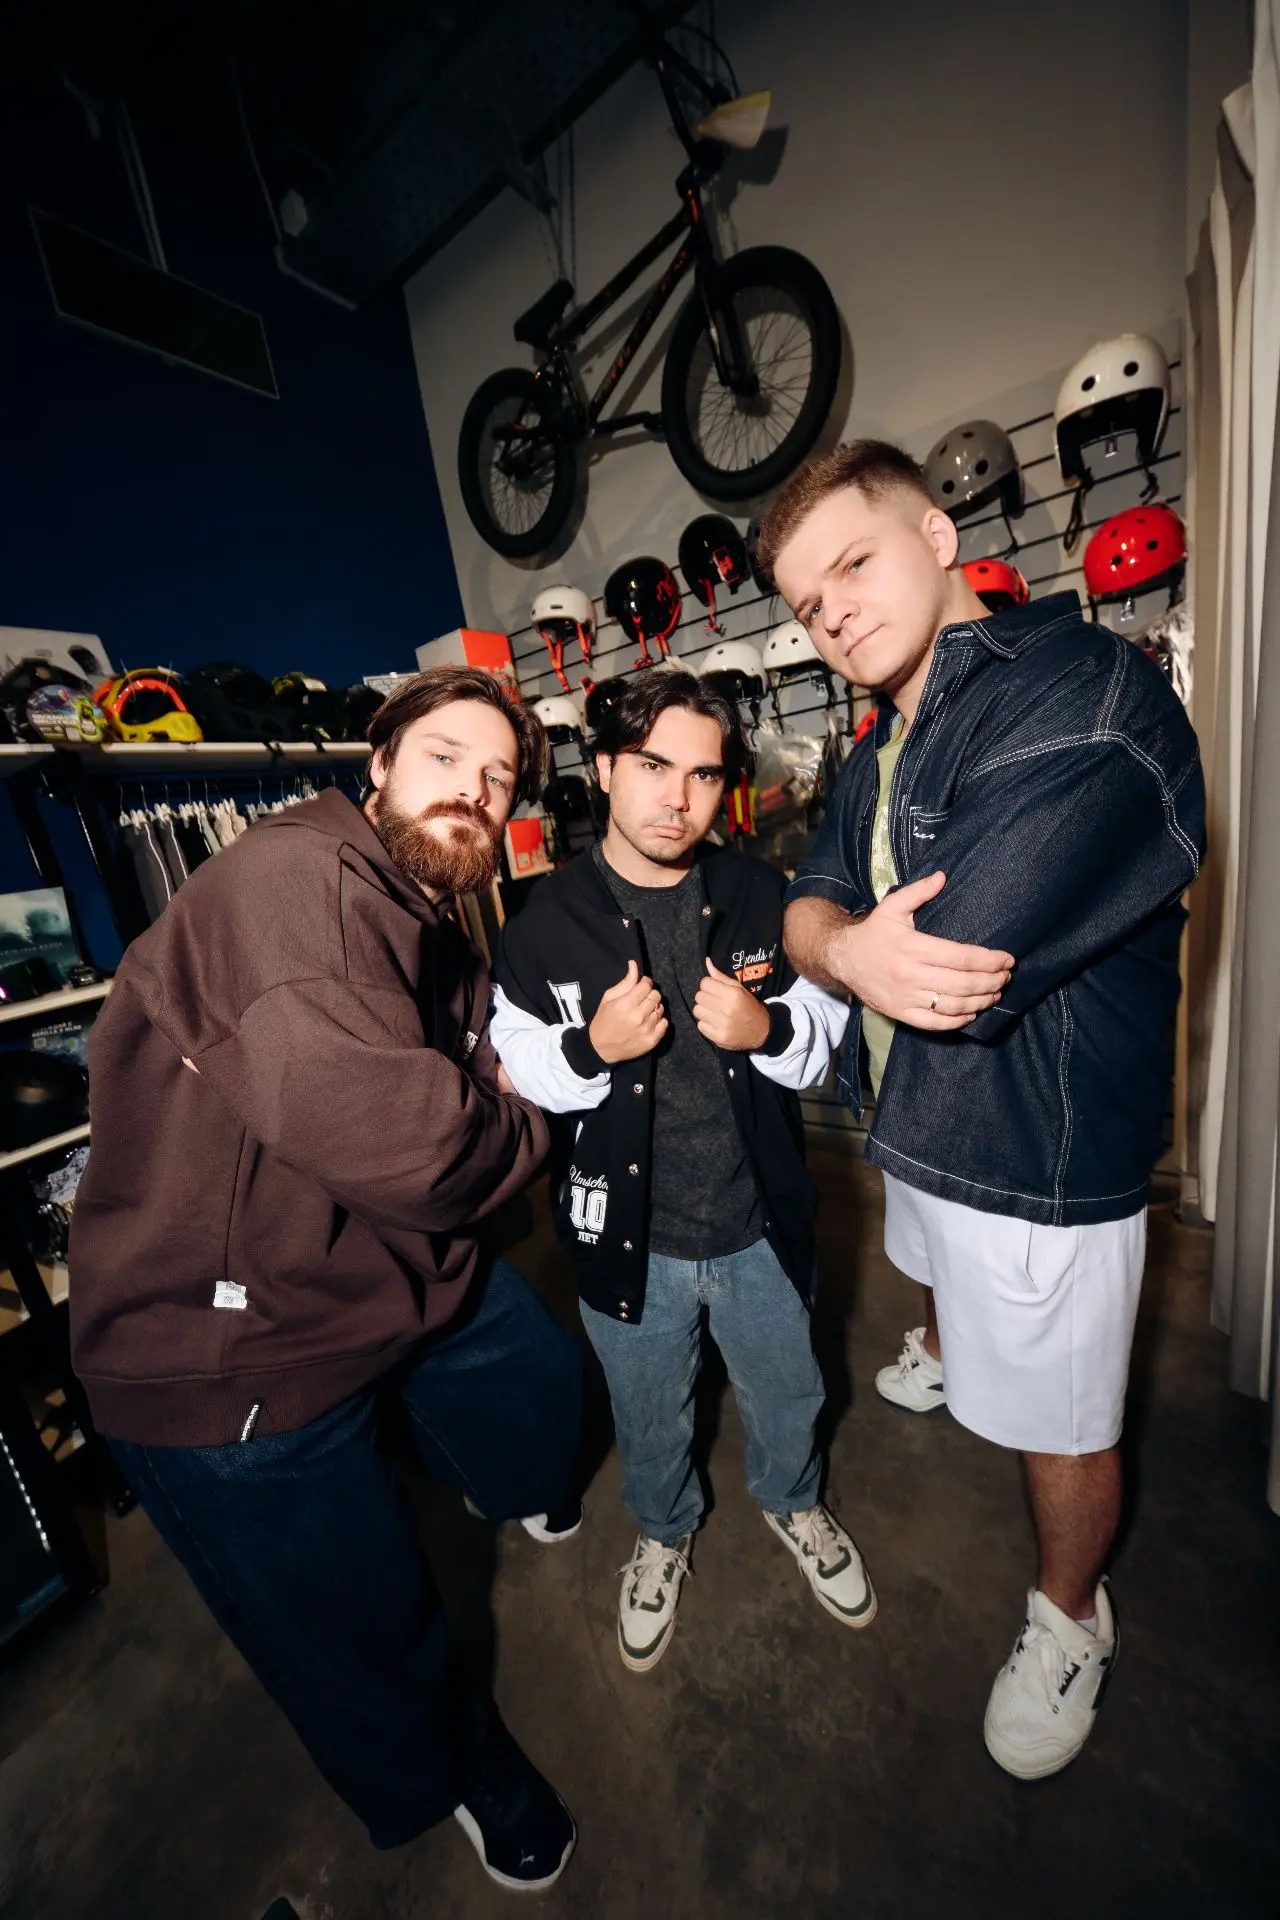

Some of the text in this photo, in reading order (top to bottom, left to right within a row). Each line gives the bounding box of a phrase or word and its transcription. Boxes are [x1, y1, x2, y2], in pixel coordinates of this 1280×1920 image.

[569, 1164, 609, 1190] Umscho
[569, 1186, 608, 1233] 10
[577, 1230, 599, 1245] ЛЕТ
